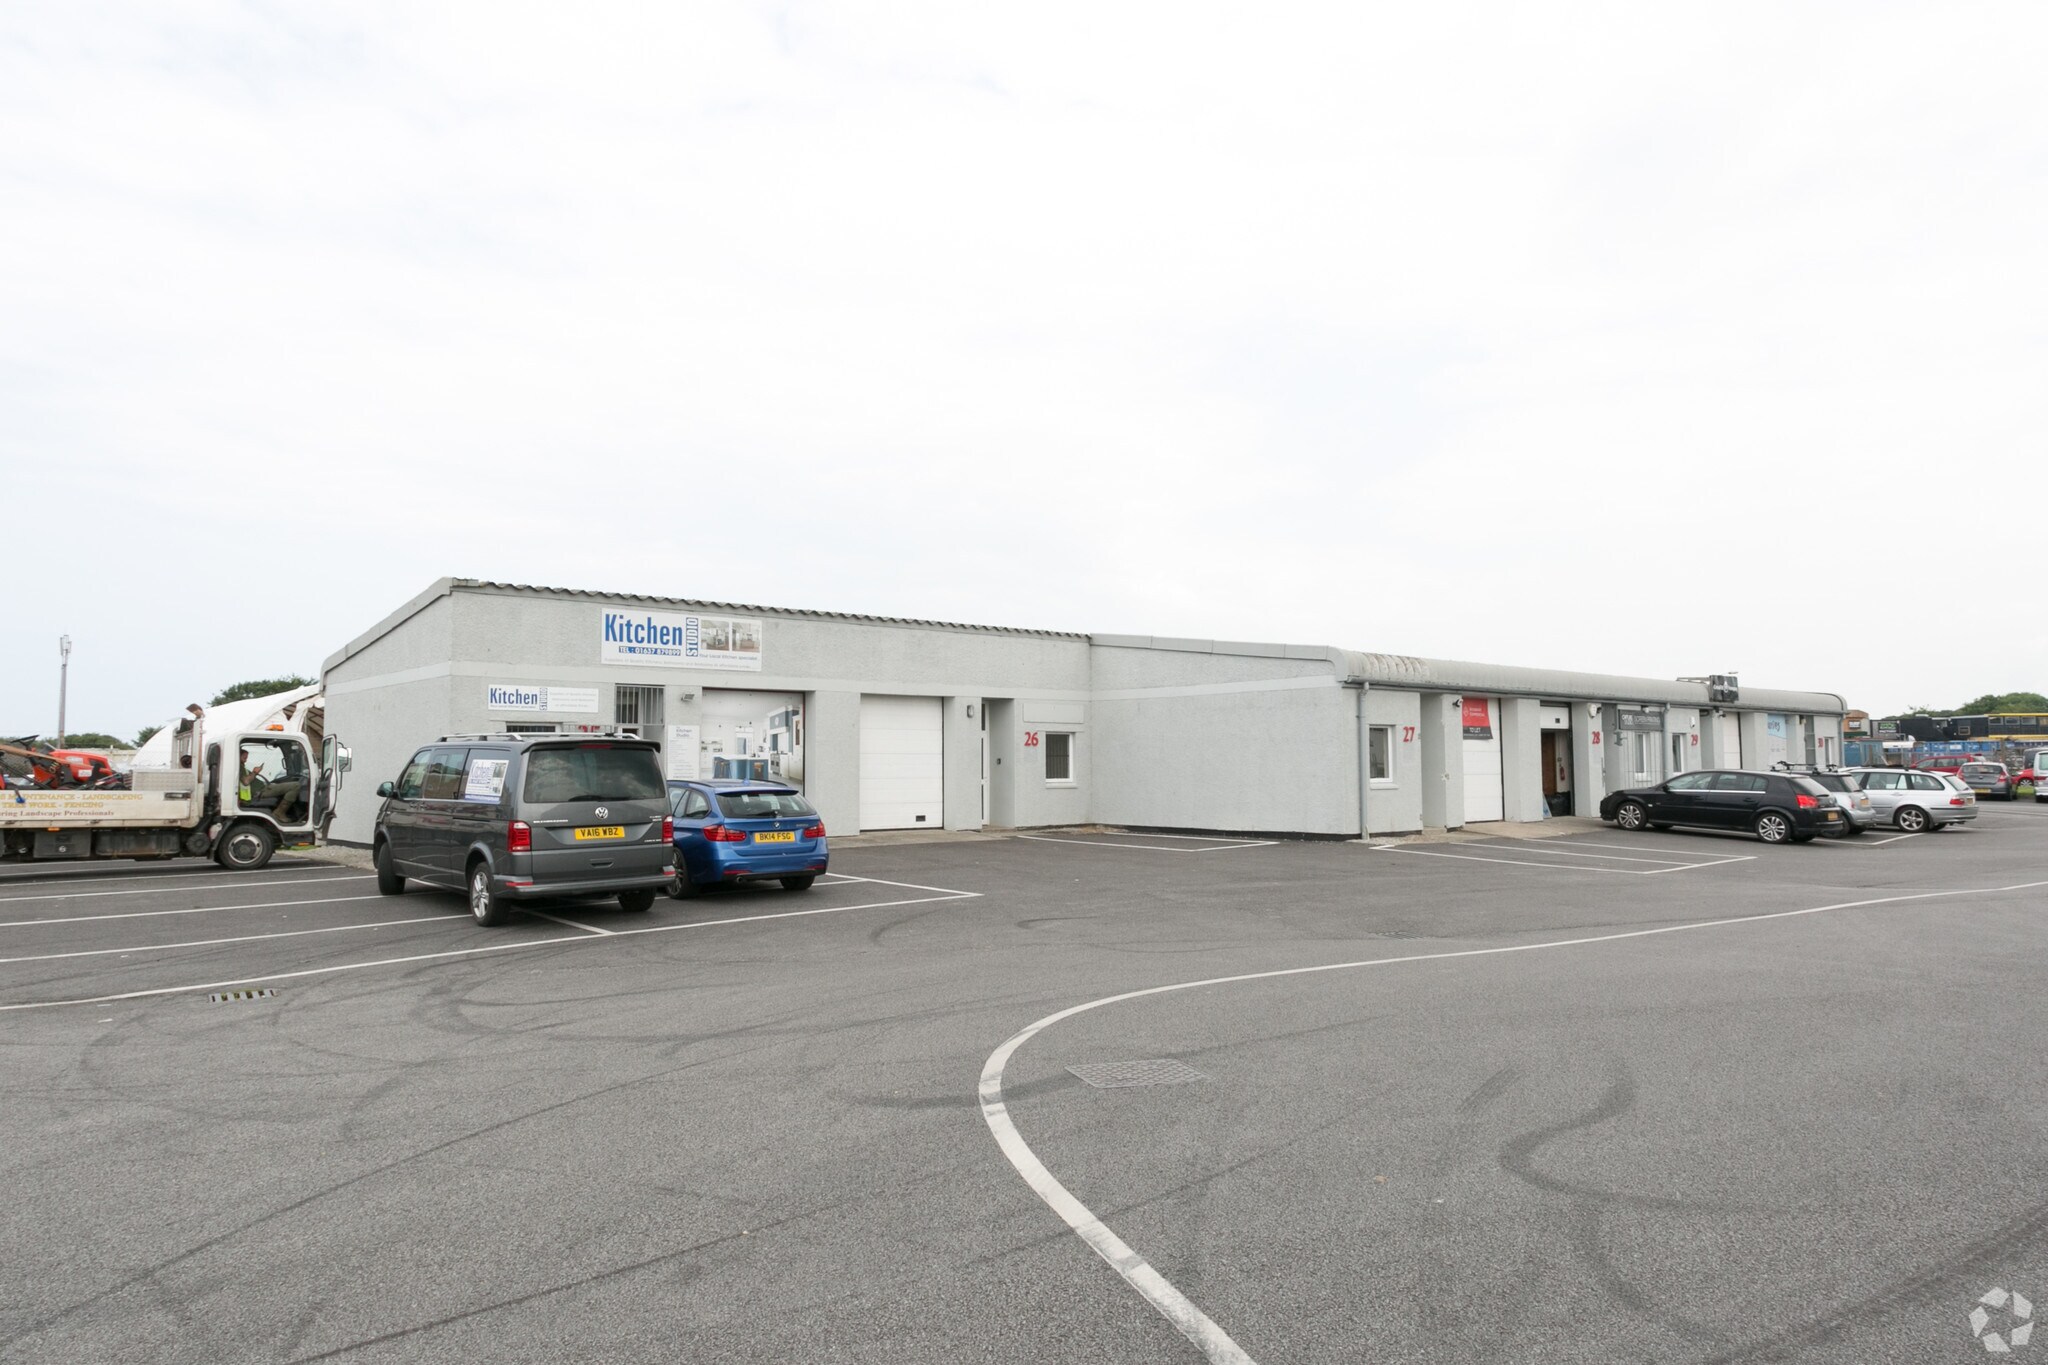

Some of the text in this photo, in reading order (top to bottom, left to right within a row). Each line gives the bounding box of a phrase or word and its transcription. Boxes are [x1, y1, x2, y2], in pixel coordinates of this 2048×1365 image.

[605, 613, 683, 646] Kitchen
[686, 617, 698, 657] STUDIO
[490, 687, 538, 705] Kitchen
[540, 687, 548, 711] STUDIO
[1024, 731, 1039, 747] 26
[1402, 726, 1415, 743] 27
[1592, 731, 1601, 745] 28
[1691, 734, 1699, 746] 29
[20, 810, 62, 818] Landscape
[580, 827, 619, 837] VA16 WBZ
[759, 832, 791, 840] BK14 FSG
